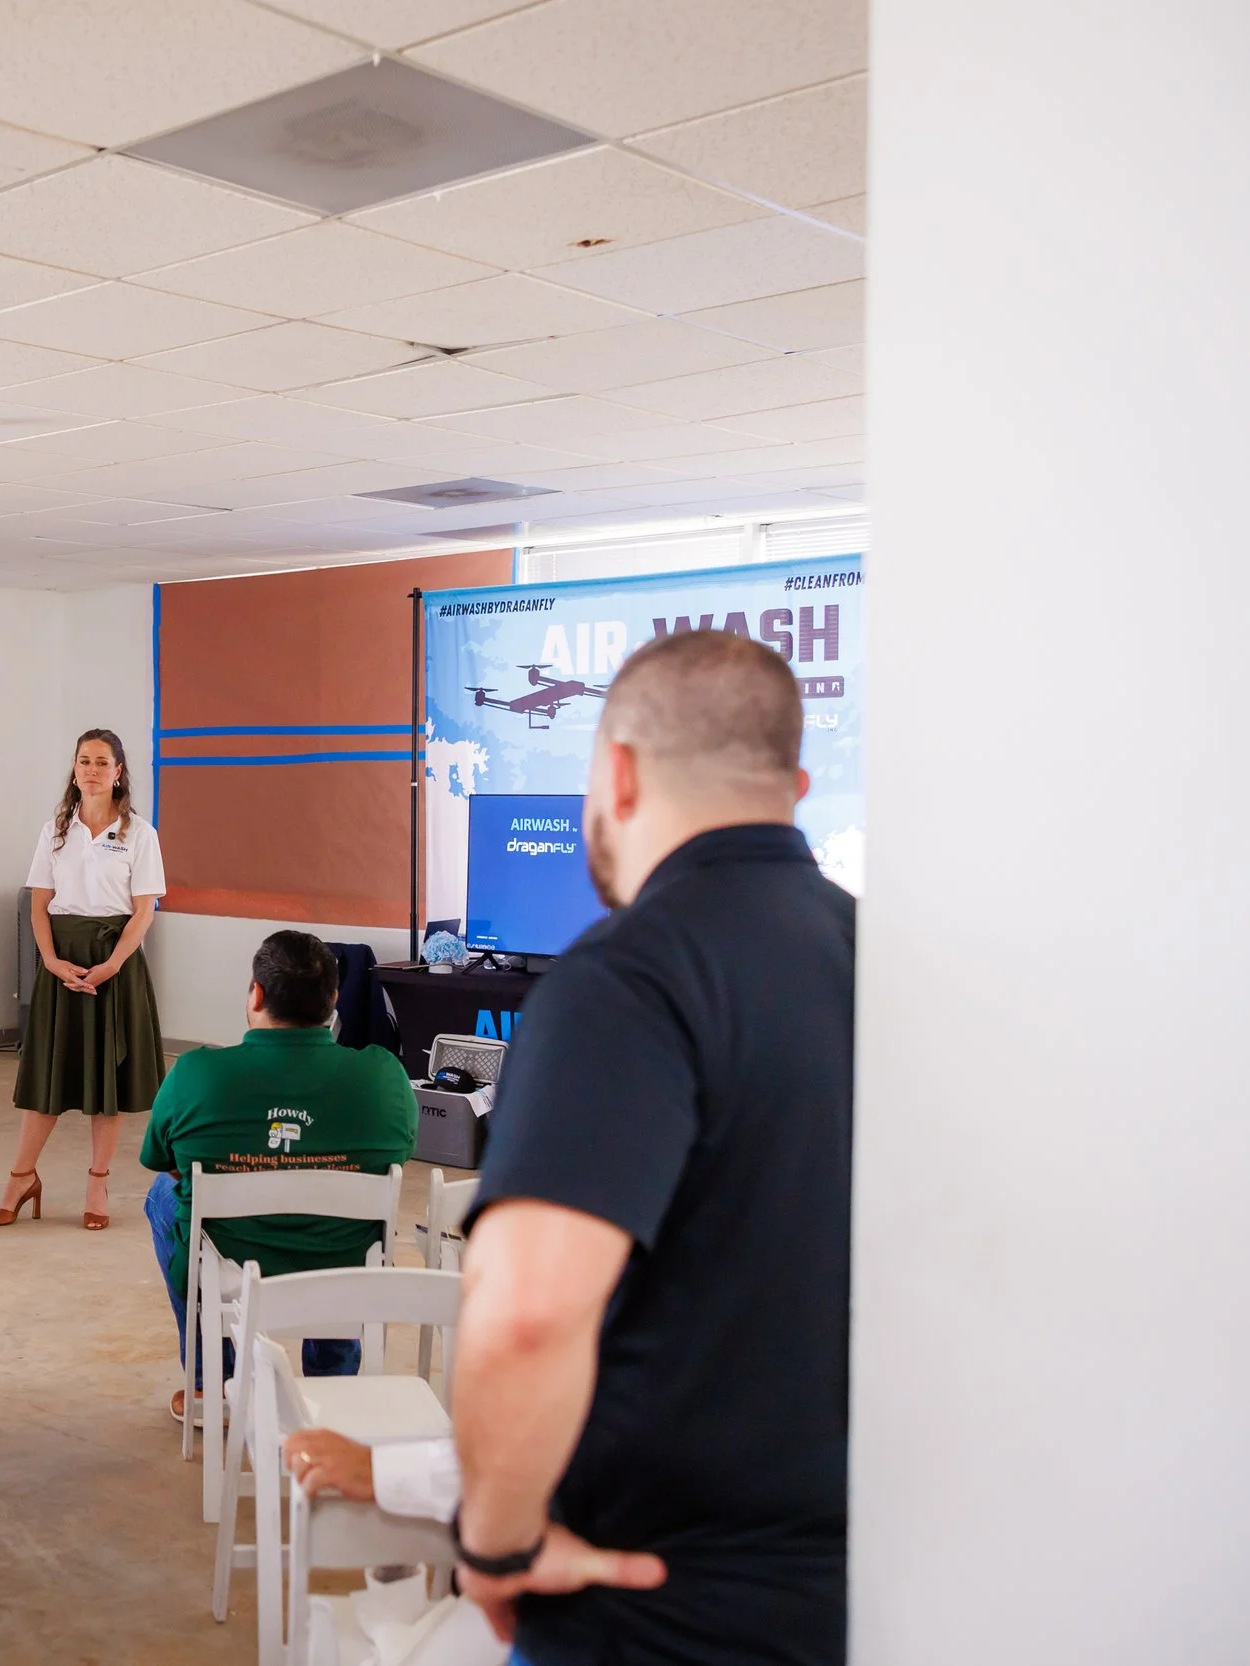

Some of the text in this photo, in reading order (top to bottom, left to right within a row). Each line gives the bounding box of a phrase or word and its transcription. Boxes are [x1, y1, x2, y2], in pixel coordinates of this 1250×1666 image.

[439, 598, 556, 617] #AIRWASHBYDRAGANFLY
[539, 621, 628, 676] AIR
[510, 818, 570, 832] AIRWASH
[474, 1009, 523, 1042] AI
[267, 1107, 315, 1127] Howdy
[422, 1105, 447, 1117] RTIC
[215, 1163, 250, 1172] reach
[321, 1163, 361, 1171] lients
[230, 1153, 279, 1168] Helping
[280, 1154, 348, 1164] businesses
